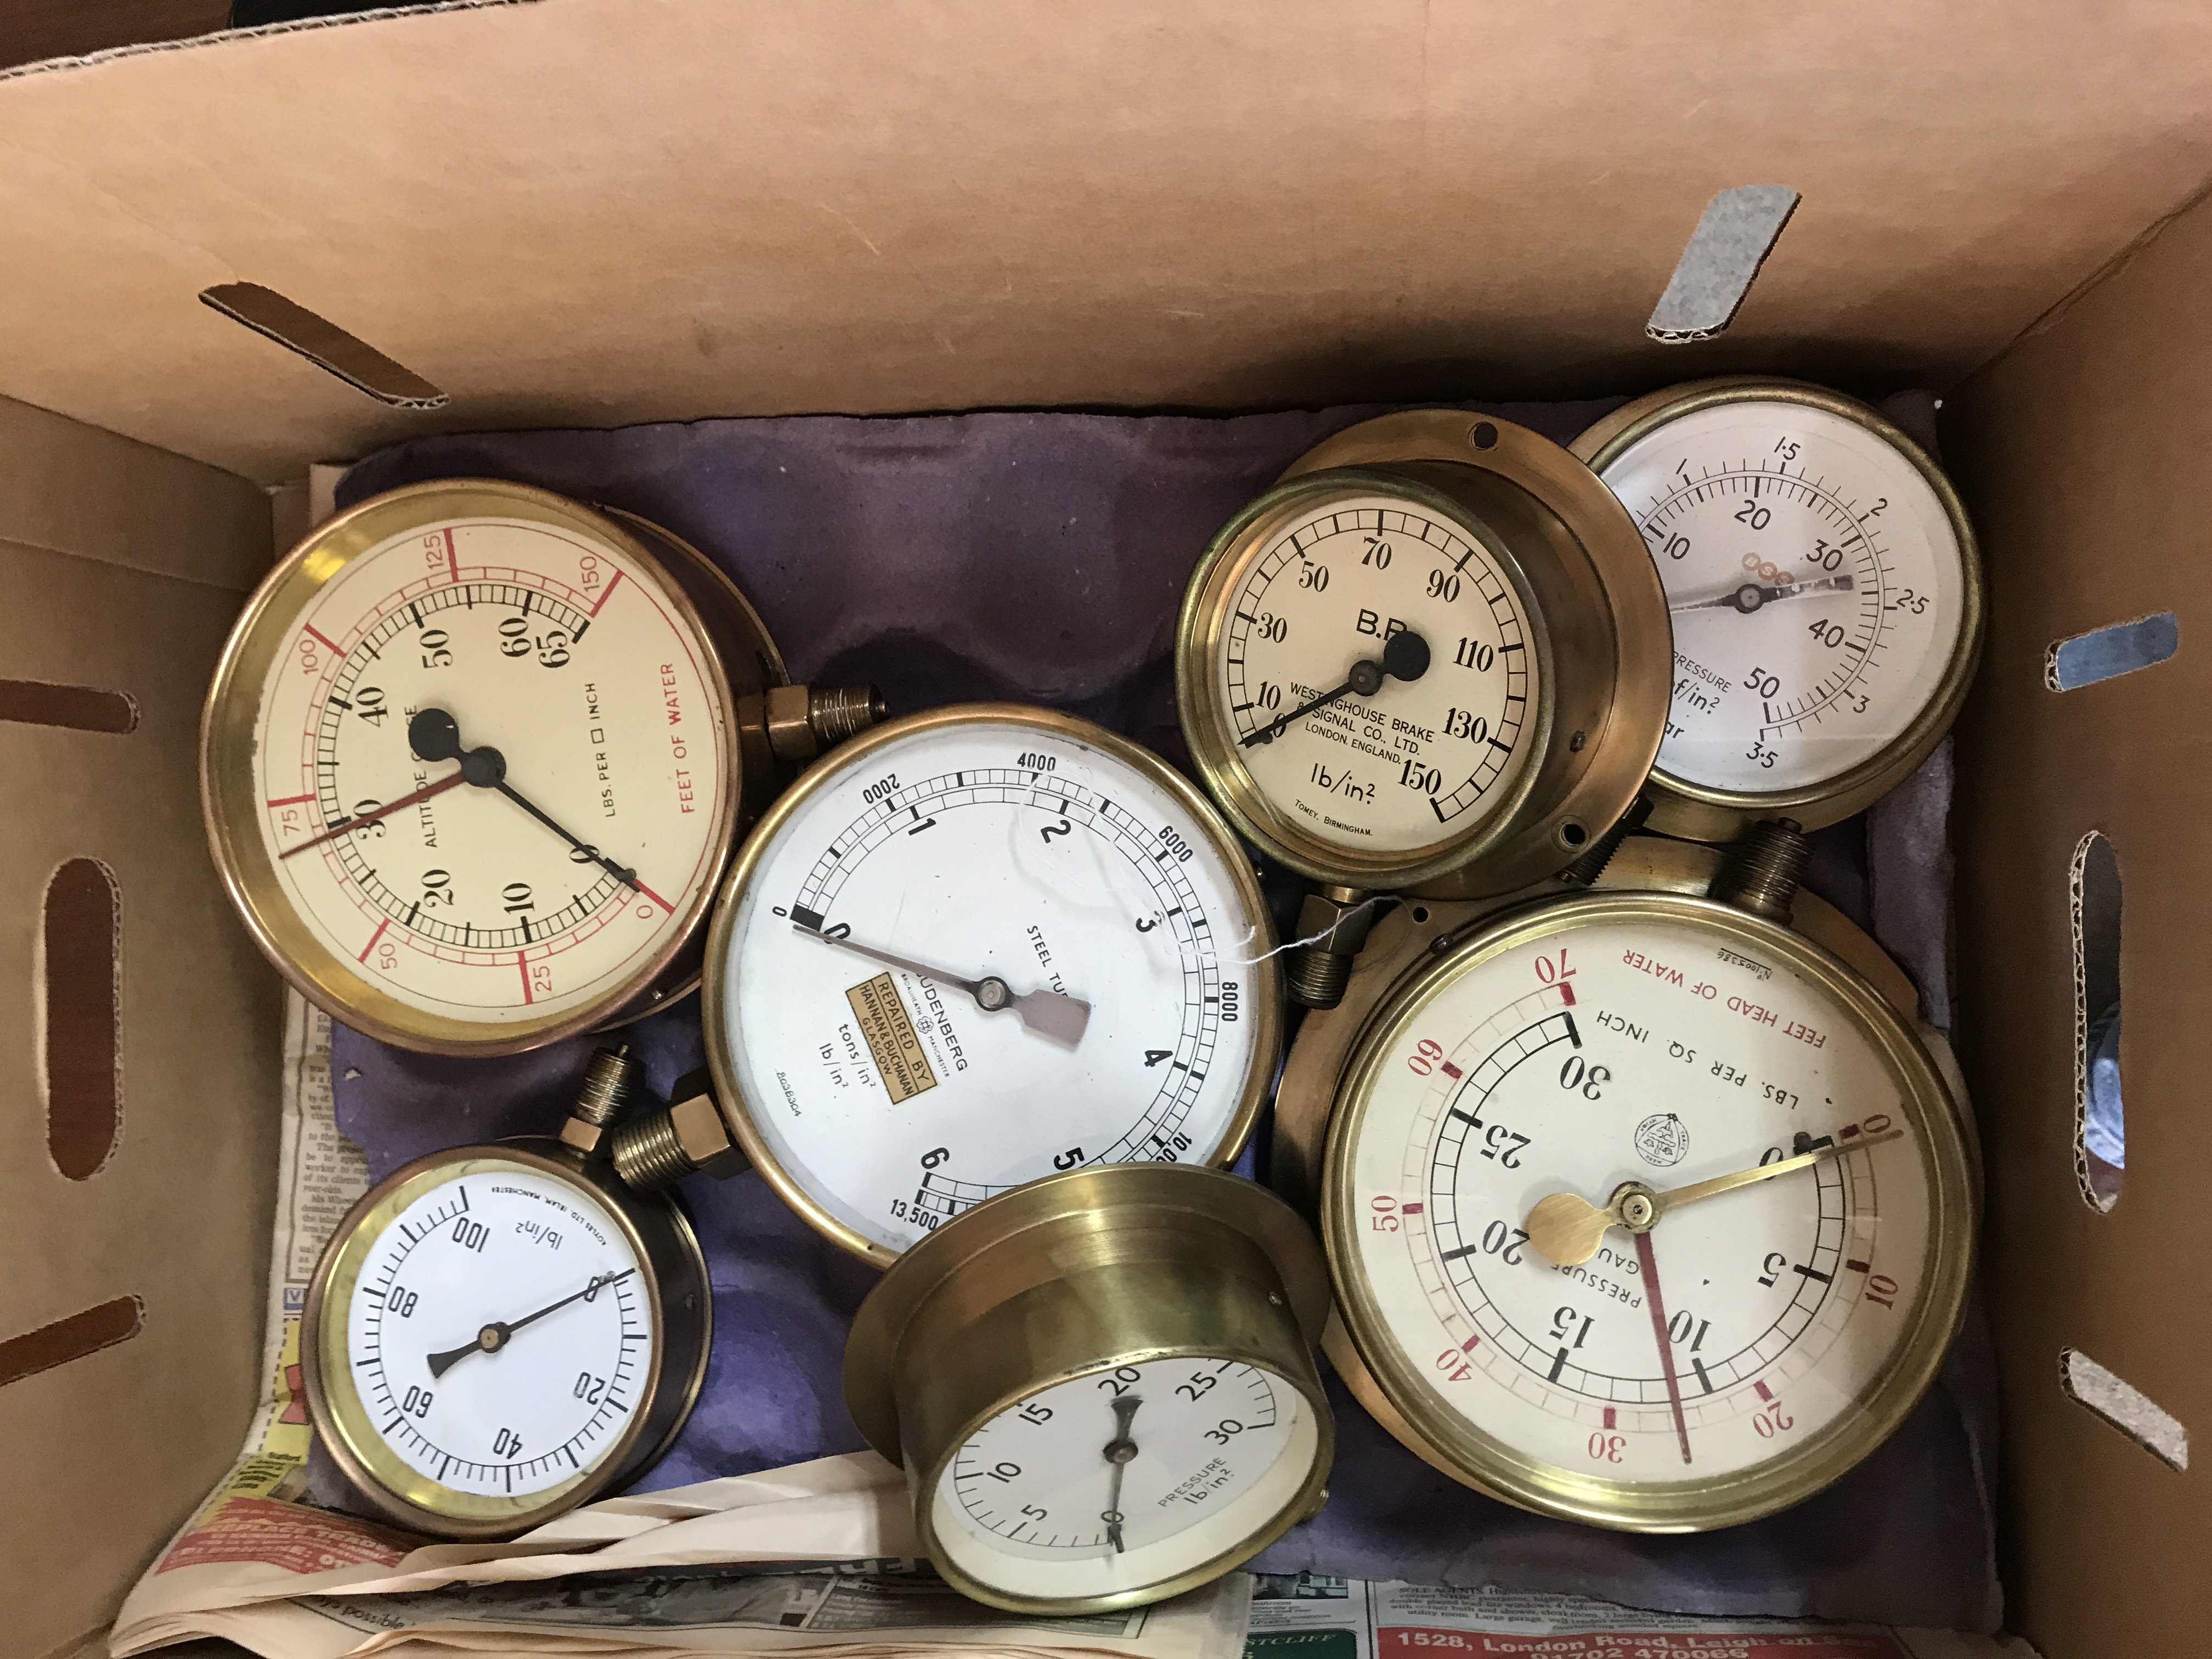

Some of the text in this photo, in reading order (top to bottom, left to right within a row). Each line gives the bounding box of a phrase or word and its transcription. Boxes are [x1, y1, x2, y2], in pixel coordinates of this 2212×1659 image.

[1734, 500, 1771, 530] 20
[1870, 498, 1888, 517] 2
[423, 535, 443, 569] 125
[1361, 537, 1392, 569] 70
[1663, 532, 1690, 560] 10
[1806, 539, 1843, 571] 30
[579, 556, 600, 592] 150
[1299, 561, 1329, 592] 50
[1426, 569, 1460, 603] 90
[498, 618, 532, 657] 60
[1257, 612, 1287, 644] 30
[1809, 619, 1844, 648] 40
[299, 640, 319, 674] 100
[419, 630, 453, 668] 50
[536, 630, 571, 668] 65
[1453, 637, 1493, 672] 110
[1255, 681, 1281, 711] 10
[1743, 668, 1780, 698] 50
[356, 687, 388, 727] 40
[585, 683, 600, 720] INCH
[1853, 695, 1870, 713] 3
[661, 663, 695, 813] FEET OF WATER
[1312, 708, 1356, 732] SIGNAL
[1394, 736, 1420, 755] LTD.
[1391, 719, 1435, 743] BRAKE
[1442, 707, 1487, 744] 130
[596, 752, 608, 781] PER
[1017, 752, 1056, 771] 4000
[1397, 759, 1441, 795] 150
[862, 774, 901, 804] 2000
[281, 810, 300, 837] 75
[354, 800, 386, 839] 30
[908, 817, 936, 836] 1
[1041, 820, 1071, 844] 2
[1159, 825, 1193, 862] 6000
[421, 870, 454, 907] 20
[501, 883, 534, 915] 10
[636, 905, 653, 919] 0
[772, 906, 787, 917] 0
[1136, 911, 1165, 933] 3
[379, 944, 398, 969] 50
[1026, 925, 1053, 968] STEEL
[533, 966, 552, 992] 25
[1534, 948, 1576, 984] 70
[1221, 981, 1238, 1022] 8000
[1623, 949, 1827, 1048] FEET HEAD OF WATER
[878, 981, 930, 1081] REPAIRED BY
[1596, 1011, 1650, 1043] INCH
[862, 1018, 893, 1075] GLASGOW
[928, 1035, 950, 1078] MANCHESTER
[1144, 1049, 1173, 1068] 4
[1408, 1039, 1443, 1076] 60
[1561, 1055, 1611, 1100] 30
[1711, 1060, 1747, 1087] PER
[1761, 1081, 1799, 1110] LBS.
[1864, 1114, 1891, 1133] 0
[921, 1147, 950, 1169] 6
[1053, 1147, 1085, 1171] 5
[1481, 1125, 1532, 1169] 25
[890, 1199, 939, 1231] 13,500
[1372, 1195, 1399, 1232] 50
[452, 1217, 490, 1252] 100
[1482, 1220, 1531, 1266] 20
[1757, 1252, 1786, 1288] 5
[388, 1286, 418, 1318] 80
[1865, 1274, 1898, 1308] 10
[1549, 1306, 1595, 1348] 15
[1668, 1310, 1712, 1353] 10
[1436, 1348, 1472, 1382] 40
[573, 1372, 606, 1405] 20
[1098, 1367, 1141, 1396] 20
[1175, 1372, 1217, 1402] 25
[403, 1385, 432, 1418] 60
[1018, 1403, 1053, 1425] 15
[1204, 1419, 1243, 1445] 30
[1753, 1401, 1794, 1438] 20
[493, 1427, 523, 1459] 40
[1588, 1432, 1627, 1463] 30
[987, 1462, 1022, 1483] 10
[1158, 1457, 1226, 1508] PRESSURE
[1022, 1504, 1048, 1521] 5
[1100, 1510, 1124, 1523] 0
[1398, 1632, 1474, 1651] 1528,
[1483, 1638, 1586, 1652] London
